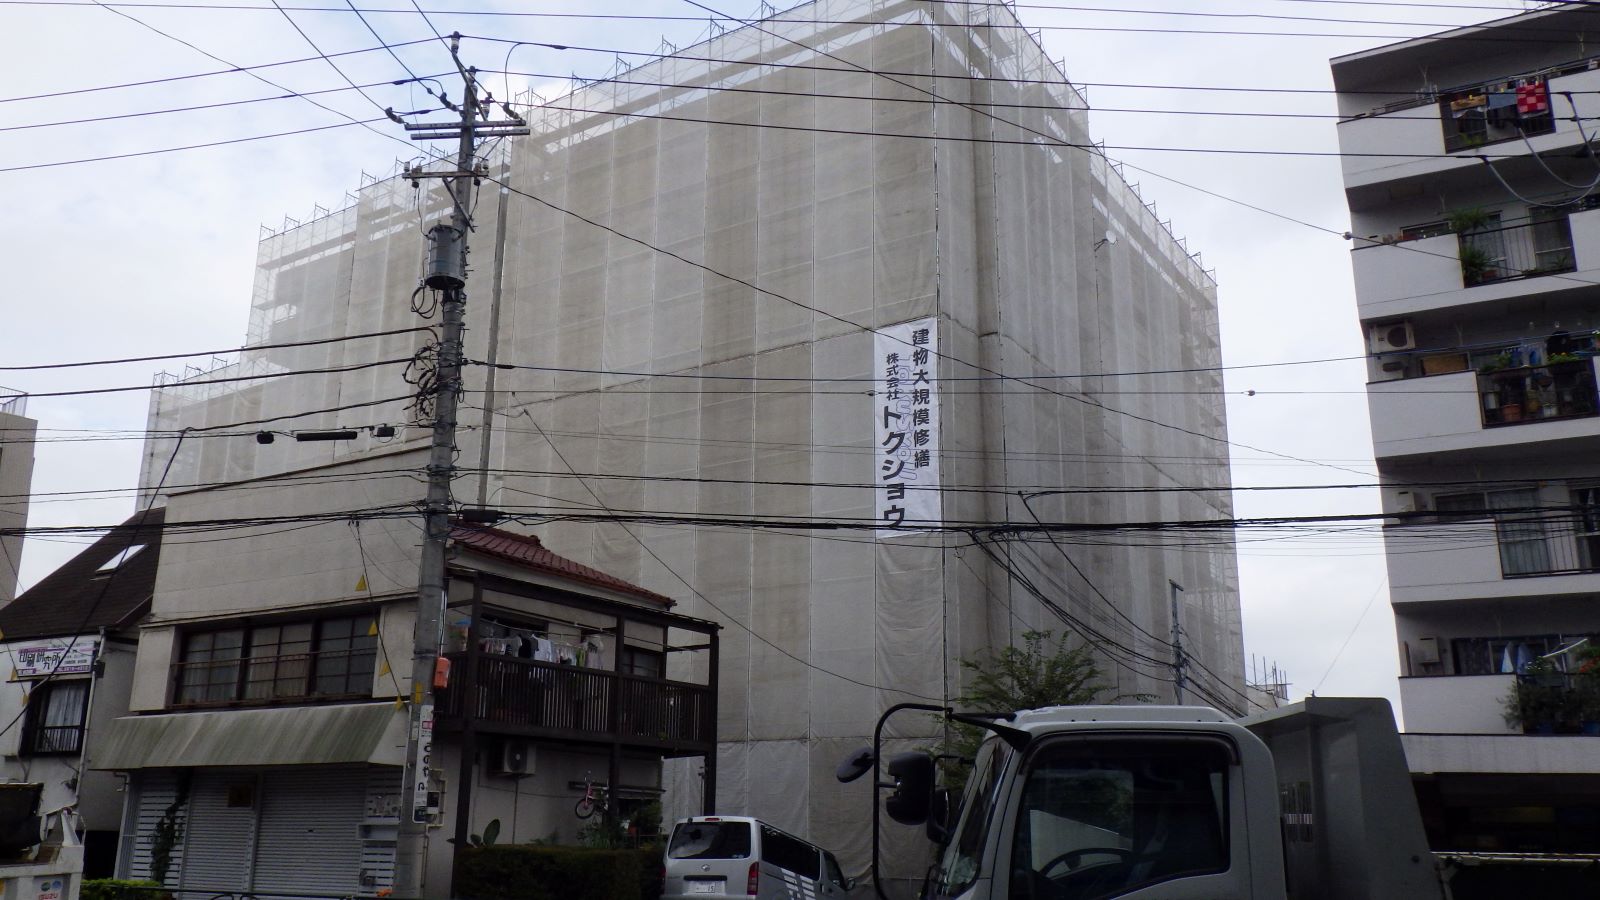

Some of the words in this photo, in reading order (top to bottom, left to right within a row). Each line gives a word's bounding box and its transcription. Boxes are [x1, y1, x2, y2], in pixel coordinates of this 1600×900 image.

[912, 328, 930, 469] 建物大規模修繕
